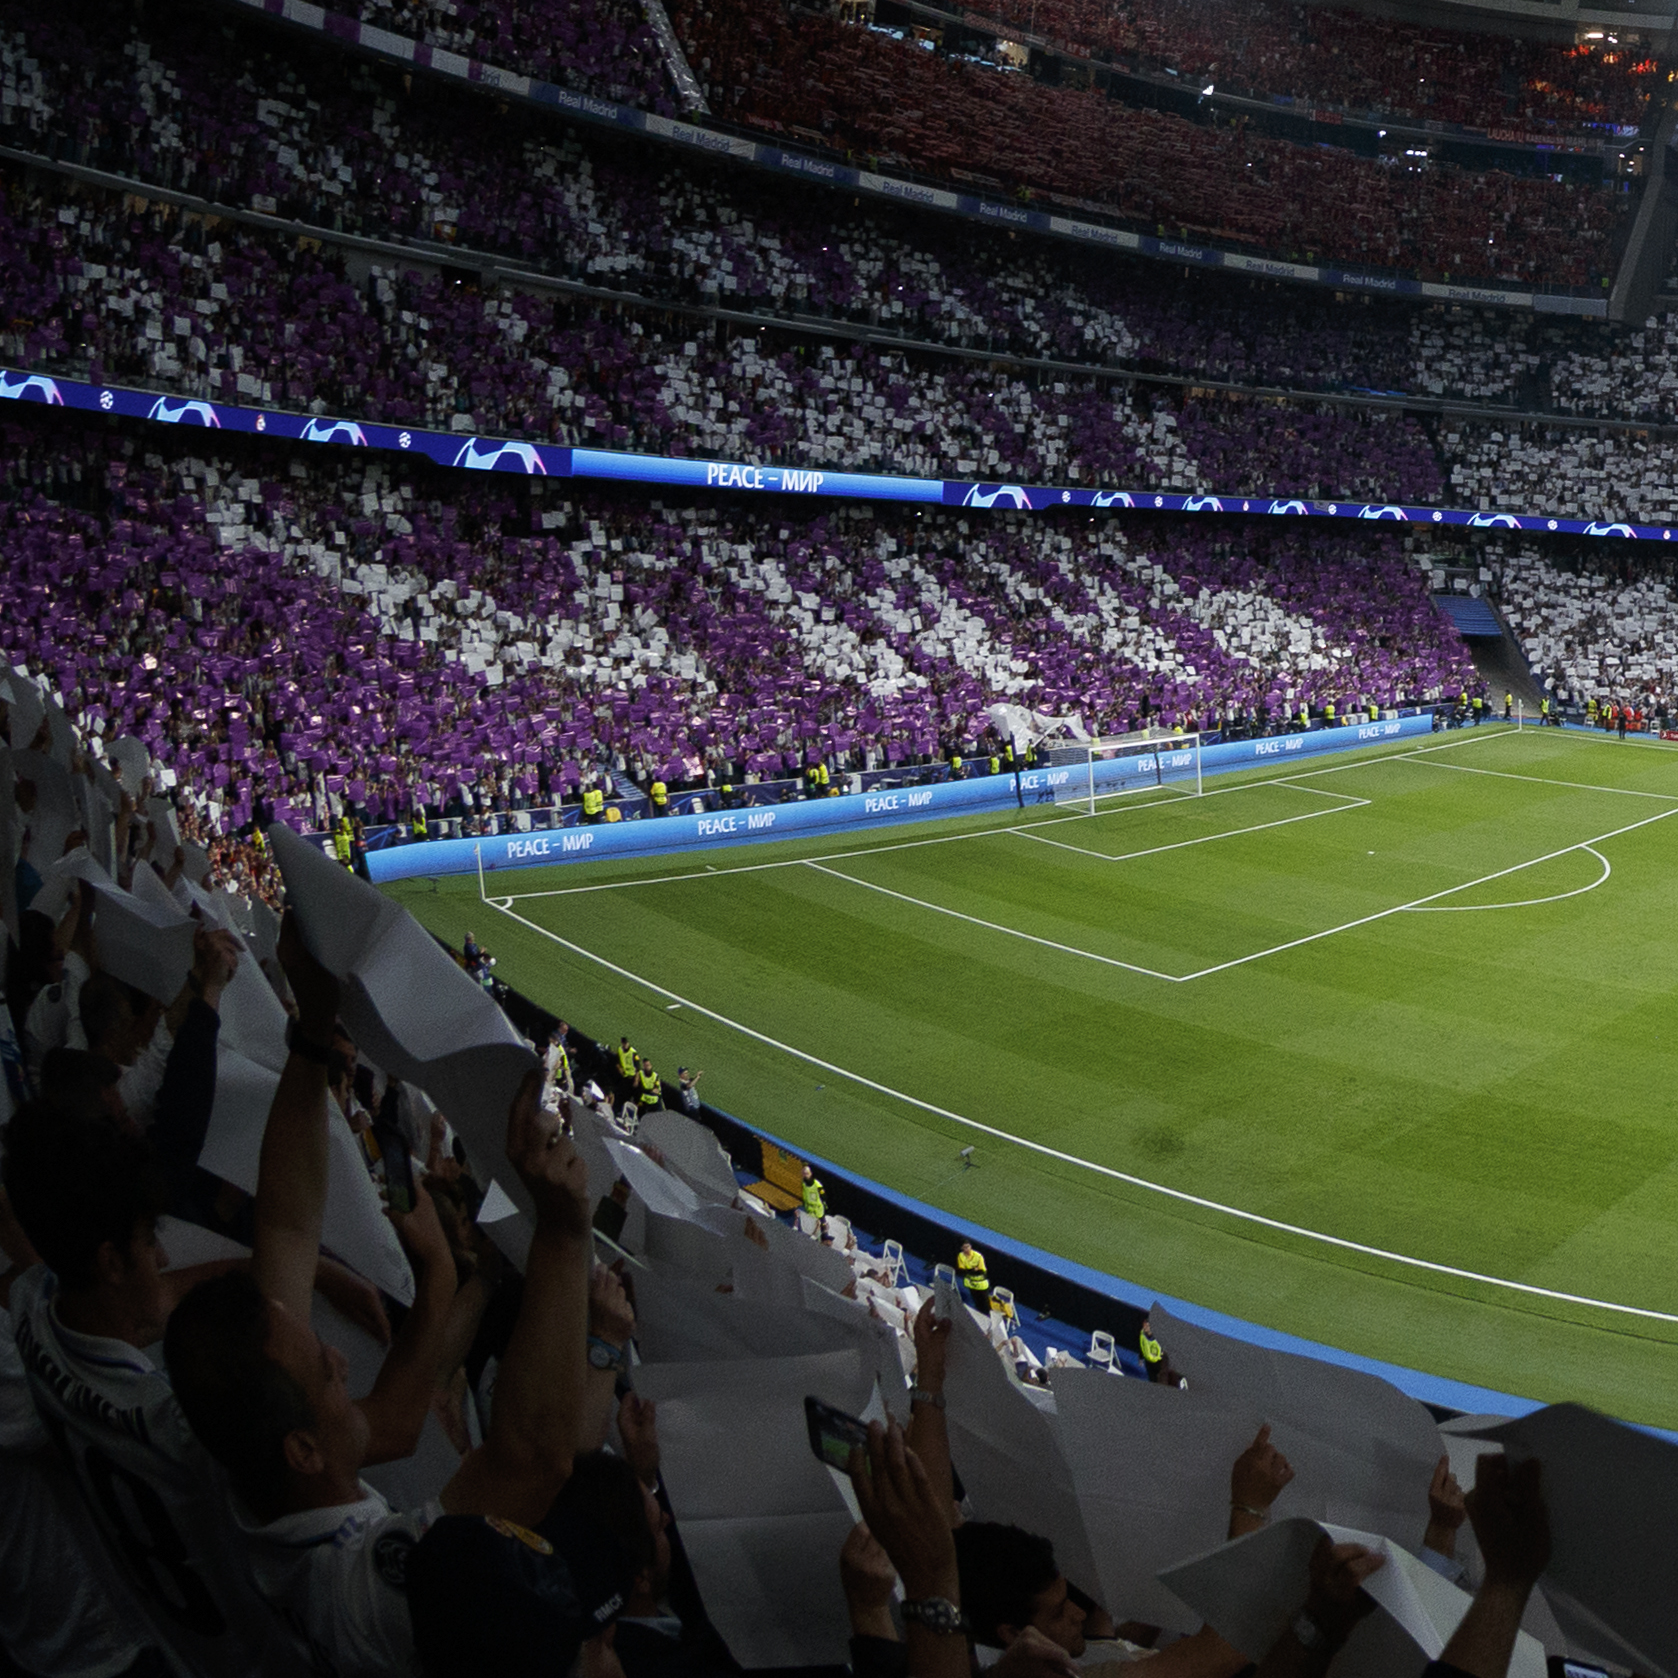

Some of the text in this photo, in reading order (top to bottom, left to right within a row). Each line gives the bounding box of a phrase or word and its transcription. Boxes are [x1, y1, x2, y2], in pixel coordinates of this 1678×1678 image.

[707, 462, 765, 489] PEACE
[1009, 775, 1039, 792] PACE
[865, 795, 899, 813] PEACE
[698, 816, 737, 836] PEACE
[507, 838, 550, 859] PEACE
[593, 1592, 625, 1623] RMCF
